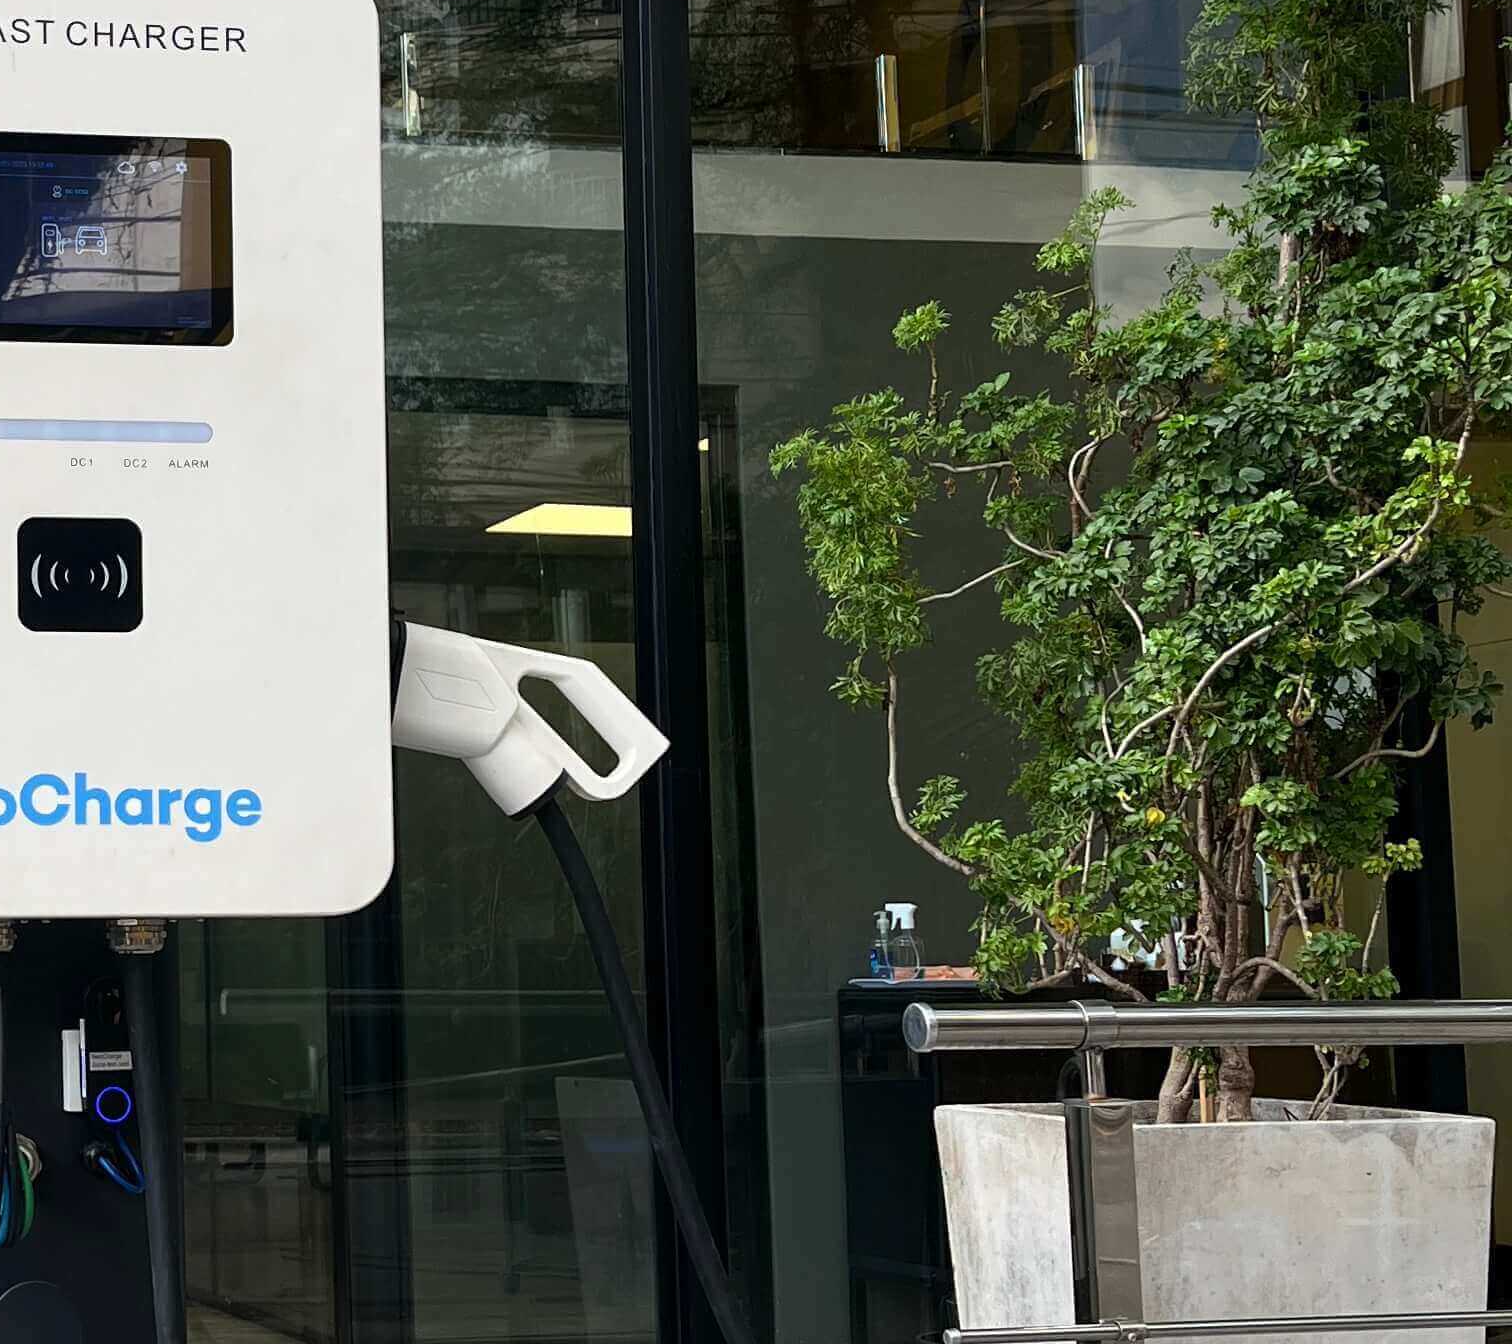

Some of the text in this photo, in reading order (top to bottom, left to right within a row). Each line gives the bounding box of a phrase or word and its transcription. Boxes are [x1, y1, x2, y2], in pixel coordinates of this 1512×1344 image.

[65, 20, 247, 52] CHARGER
[70, 457, 93, 467] DC1
[123, 458, 148, 468] DC2
[168, 459, 209, 469] ALARM
